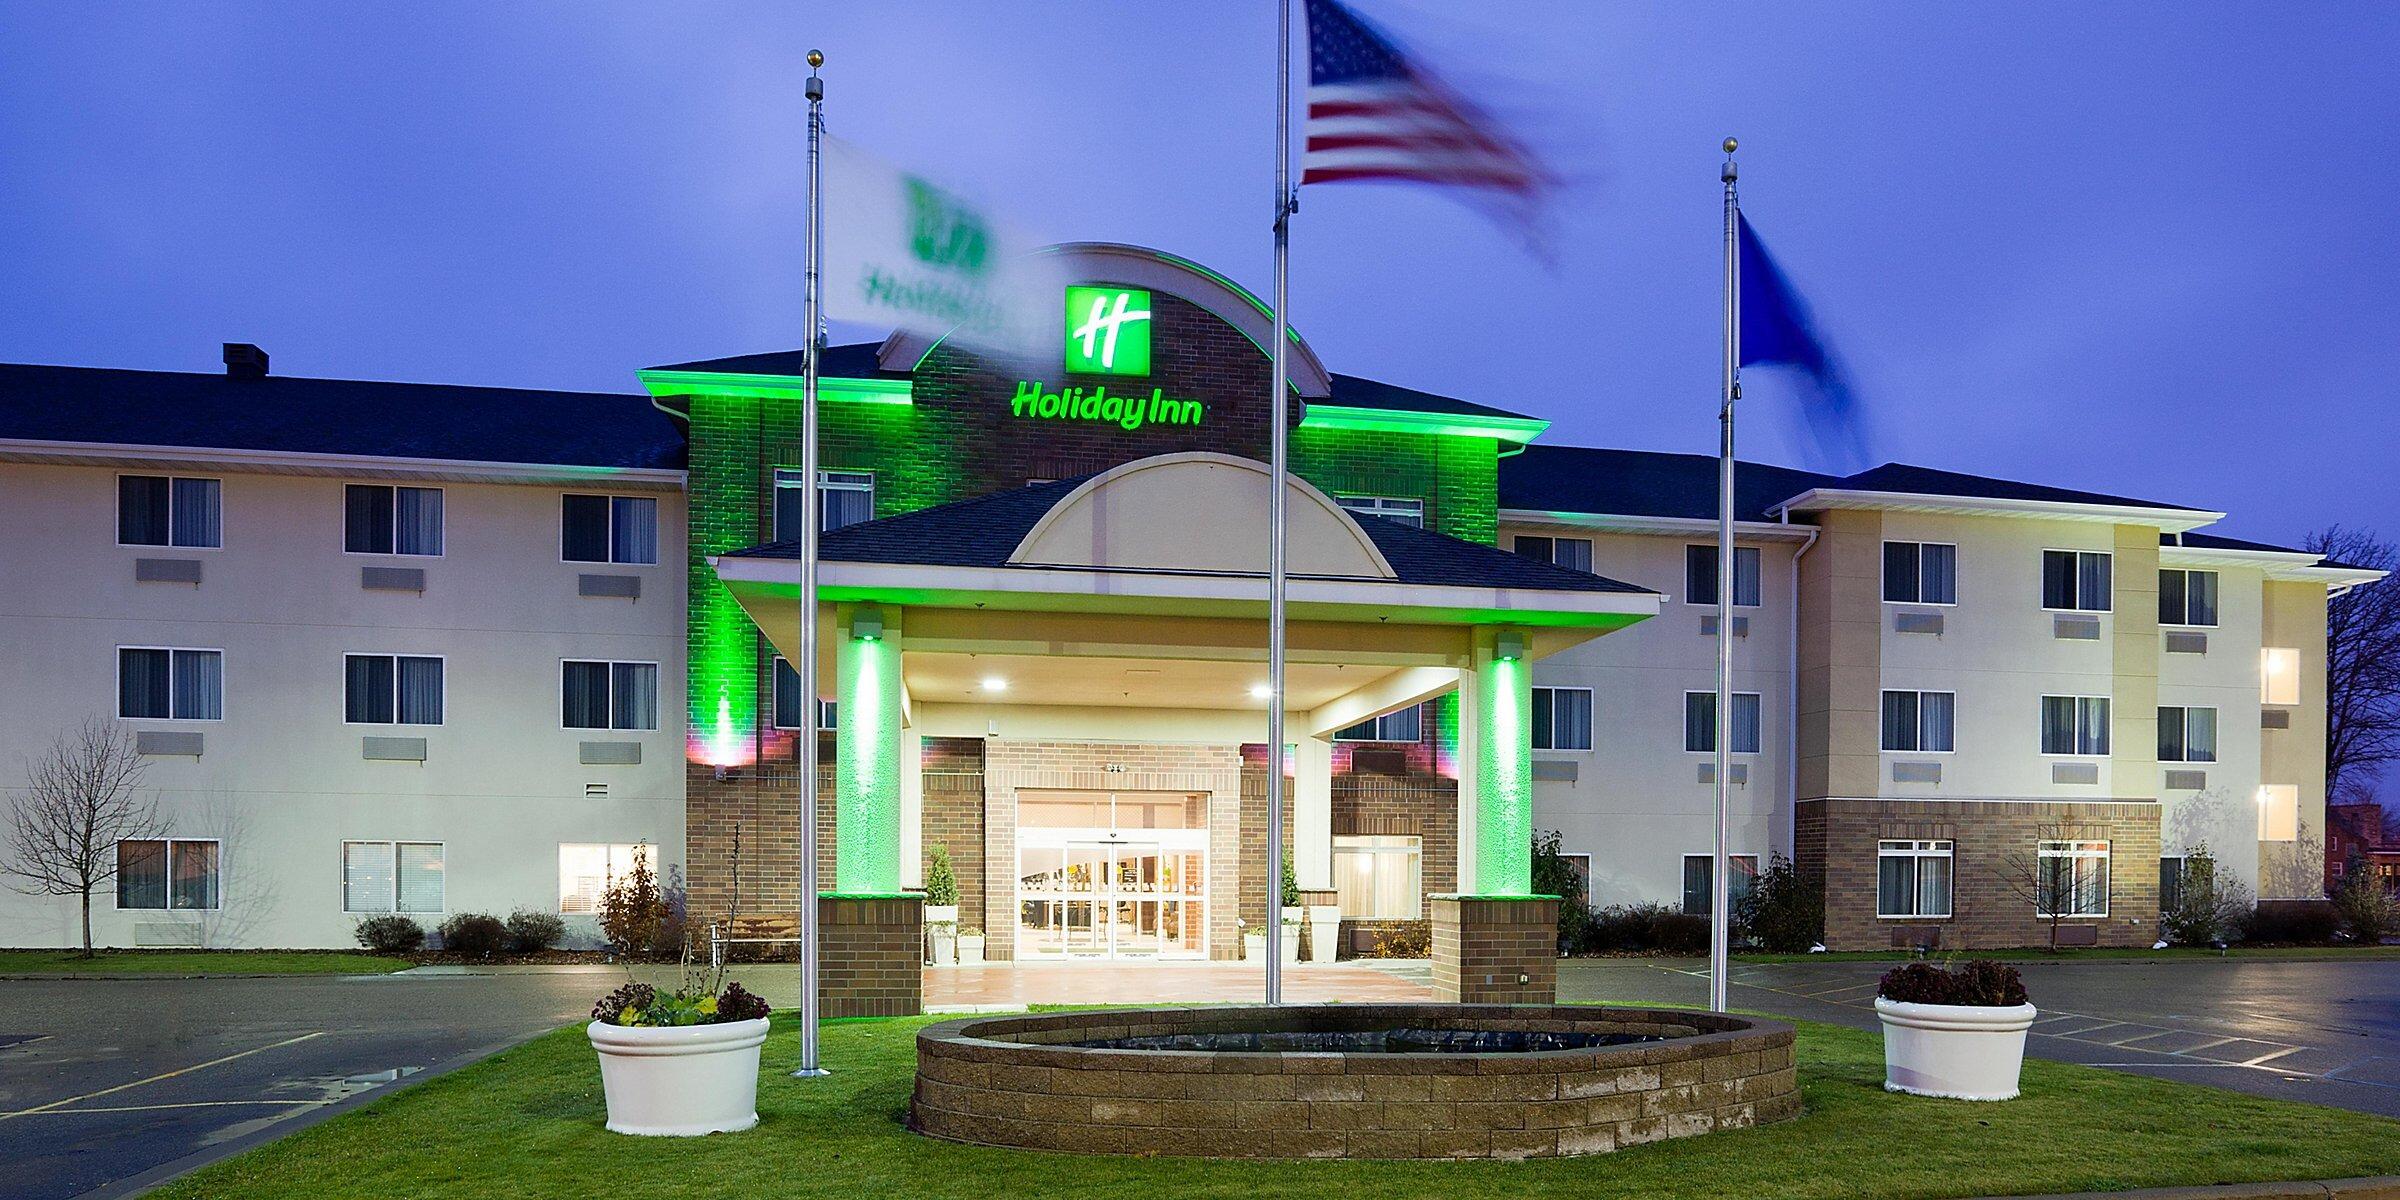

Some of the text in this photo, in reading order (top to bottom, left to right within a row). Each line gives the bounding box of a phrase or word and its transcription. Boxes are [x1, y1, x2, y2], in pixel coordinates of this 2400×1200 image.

[1073, 293, 1150, 368] H
[1011, 381, 1202, 430] Holiday Inn
